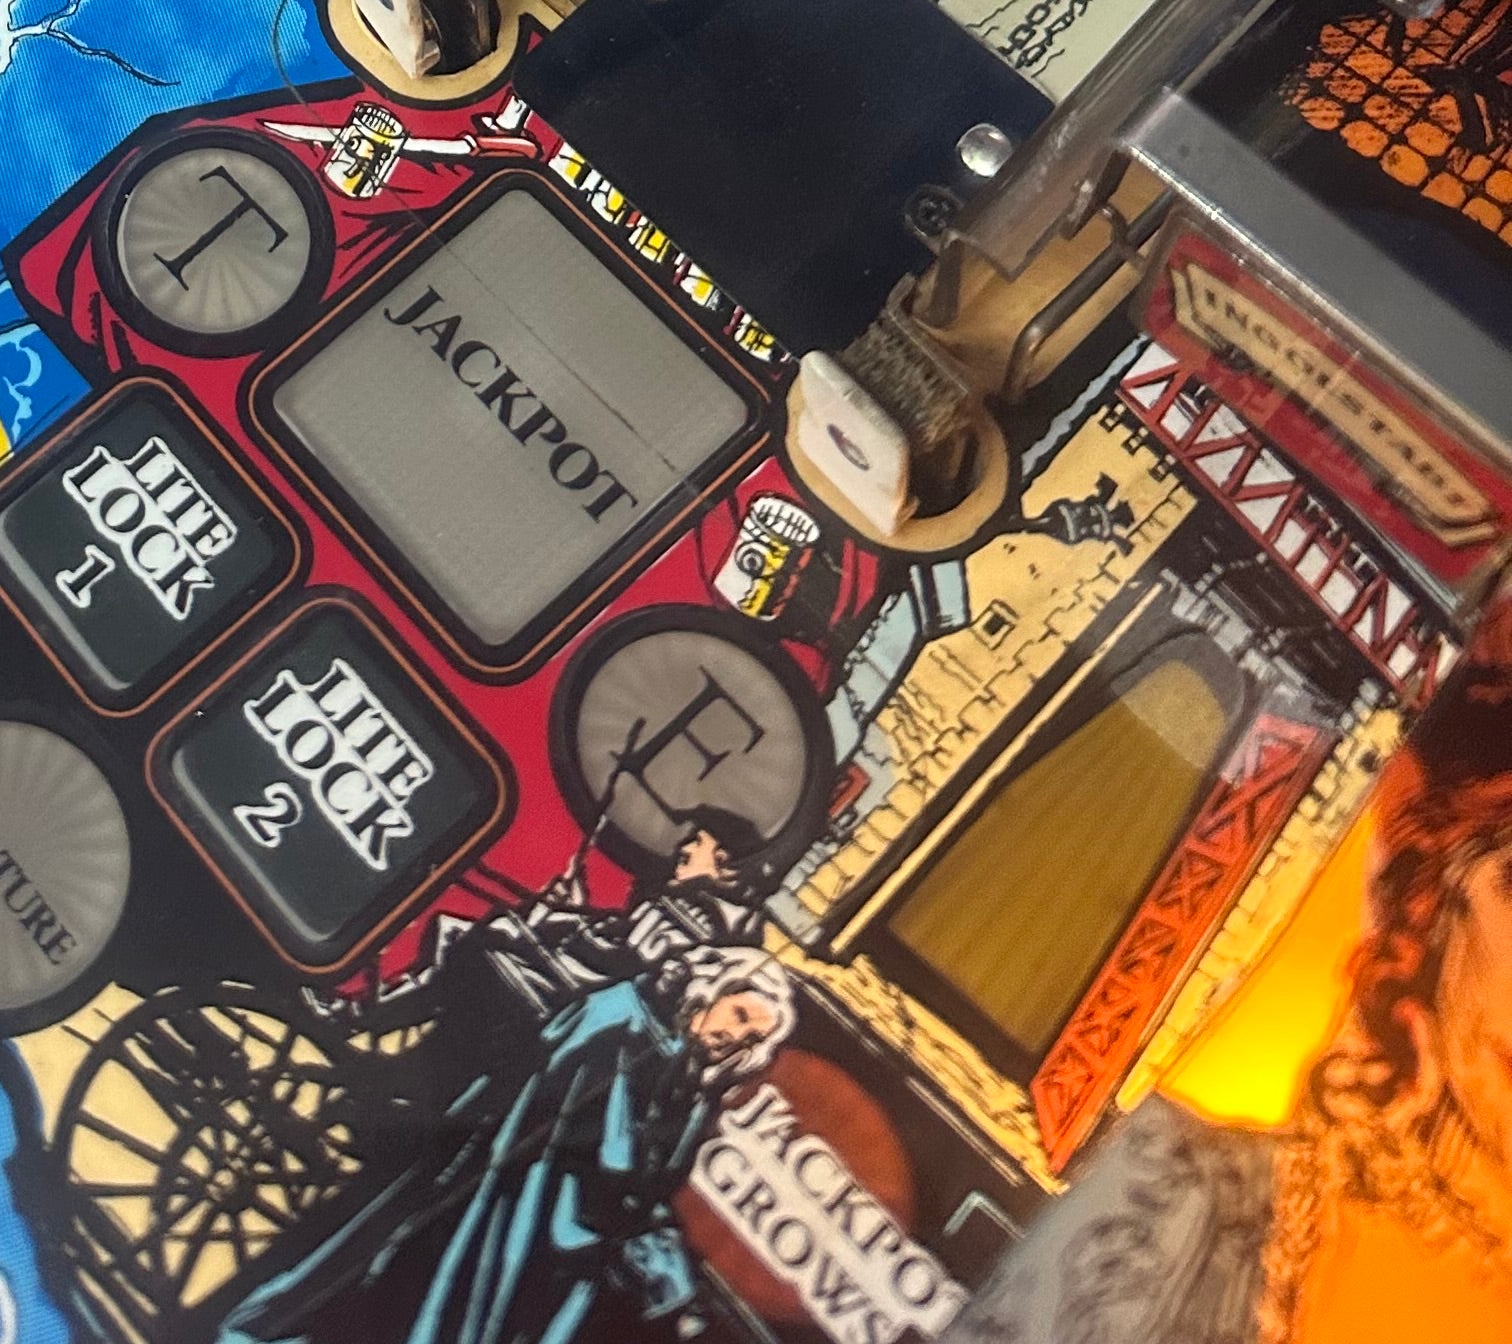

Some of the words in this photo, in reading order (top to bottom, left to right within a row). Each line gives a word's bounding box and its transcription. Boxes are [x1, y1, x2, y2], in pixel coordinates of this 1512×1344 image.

[153, 164, 289, 292] T
[382, 284, 639, 525] JACKPOT
[63, 446, 215, 619] LOCK
[125, 436, 237, 559] LITE
[55, 544, 115, 607] 1
[243, 669, 414, 870] LOCK
[307, 658, 435, 806] LITE
[233, 782, 303, 848] 2
[726, 1092, 940, 1309] JACKPO
